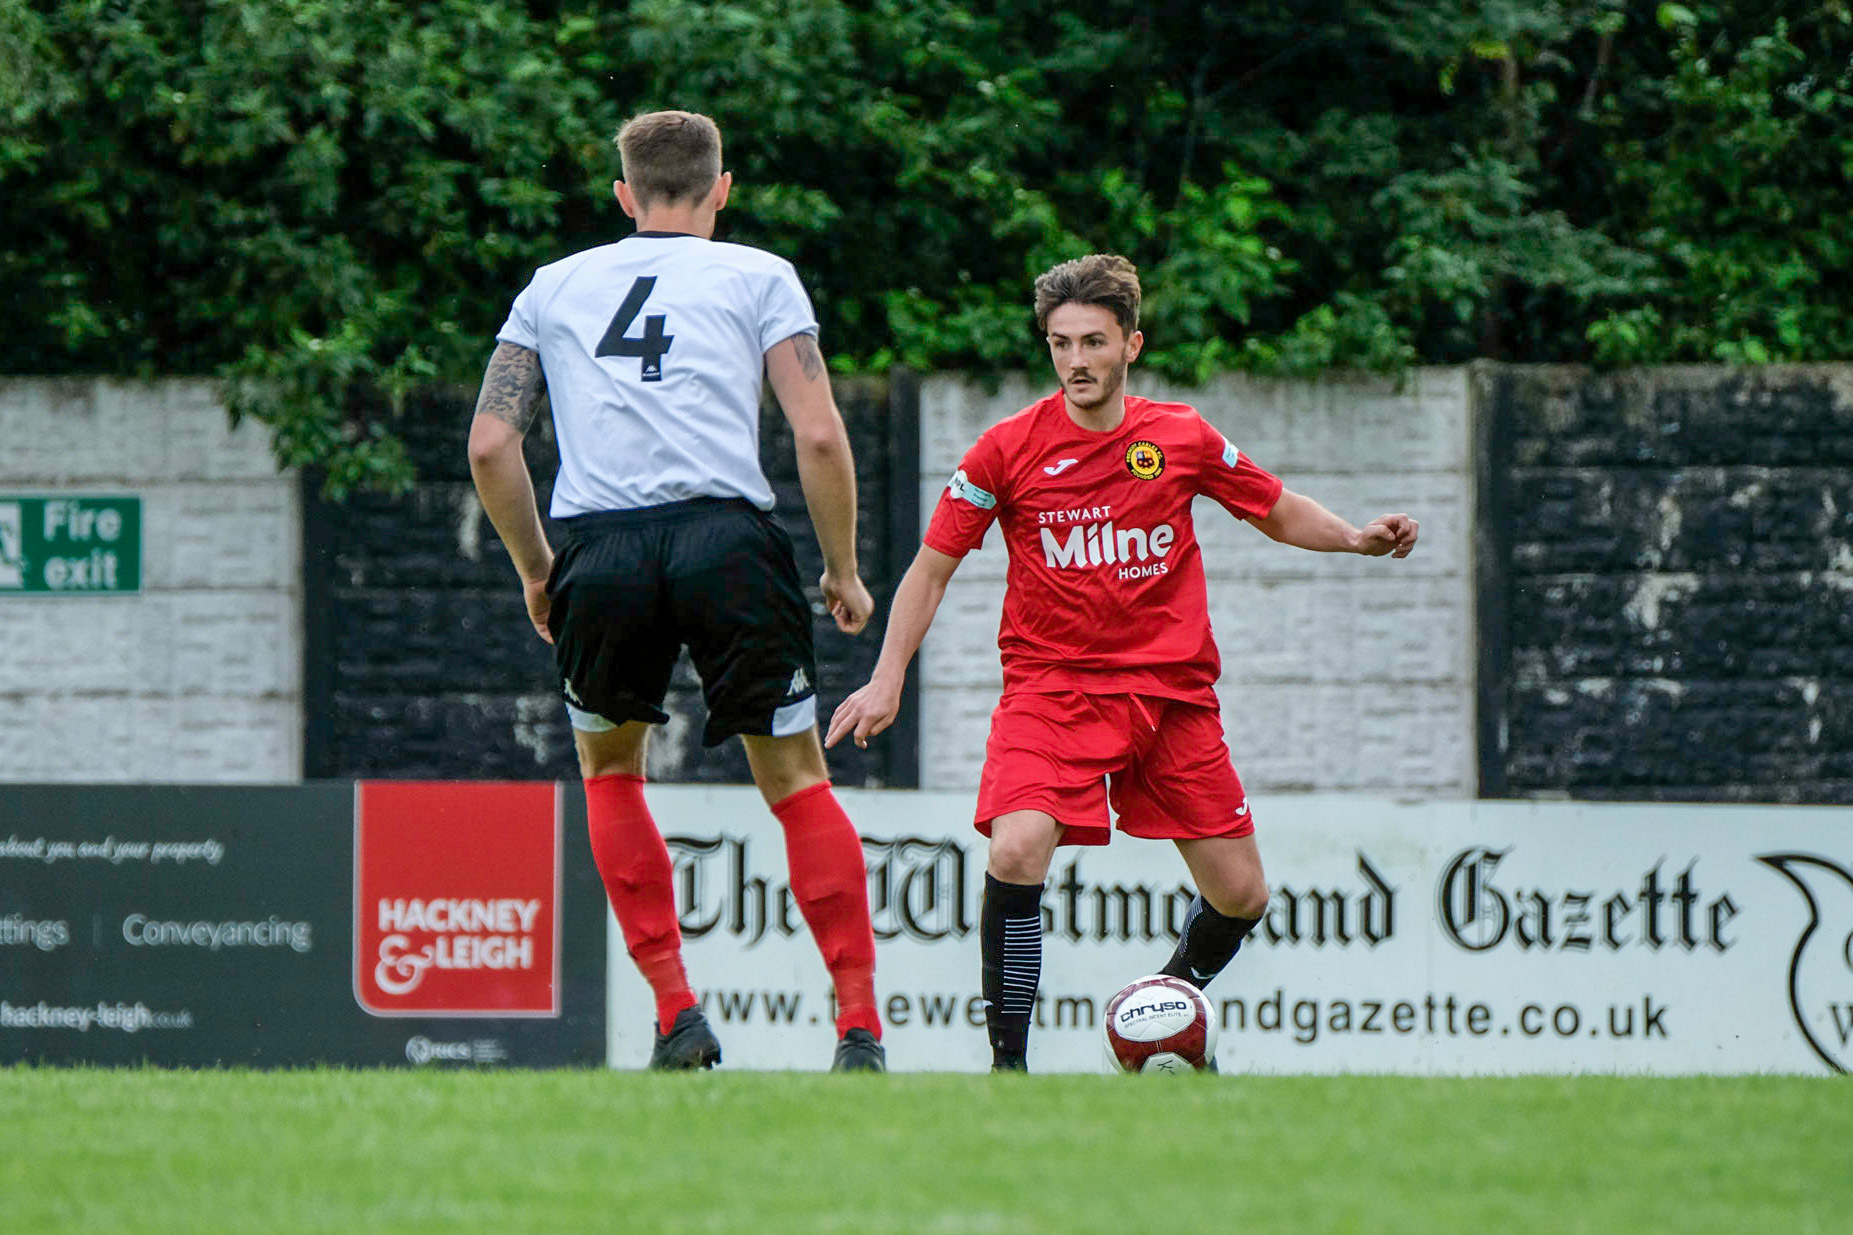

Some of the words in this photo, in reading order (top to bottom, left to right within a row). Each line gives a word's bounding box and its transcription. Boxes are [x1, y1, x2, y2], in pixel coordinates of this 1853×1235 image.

[594, 275, 675, 382] 4
[43, 501, 122, 542] Fire
[1038, 505, 1111, 524] STEWART
[1040, 520, 1174, 569] Milne
[43, 547, 118, 591] exit
[1118, 562, 1169, 580] HOMES
[43, 841, 76, 865] you
[77, 834, 114, 858] and
[108, 842, 150, 865] your
[150, 837, 226, 865] property
[665, 833, 800, 947] The
[860, 834, 1398, 947] Wtmoand
[1438, 845, 1741, 953] Gazette
[122, 913, 312, 952] Conveyancing
[378, 898, 541, 933] HACKNEY
[434, 935, 534, 969] LEIGH
[1121, 1001, 1187, 1022] chryso
